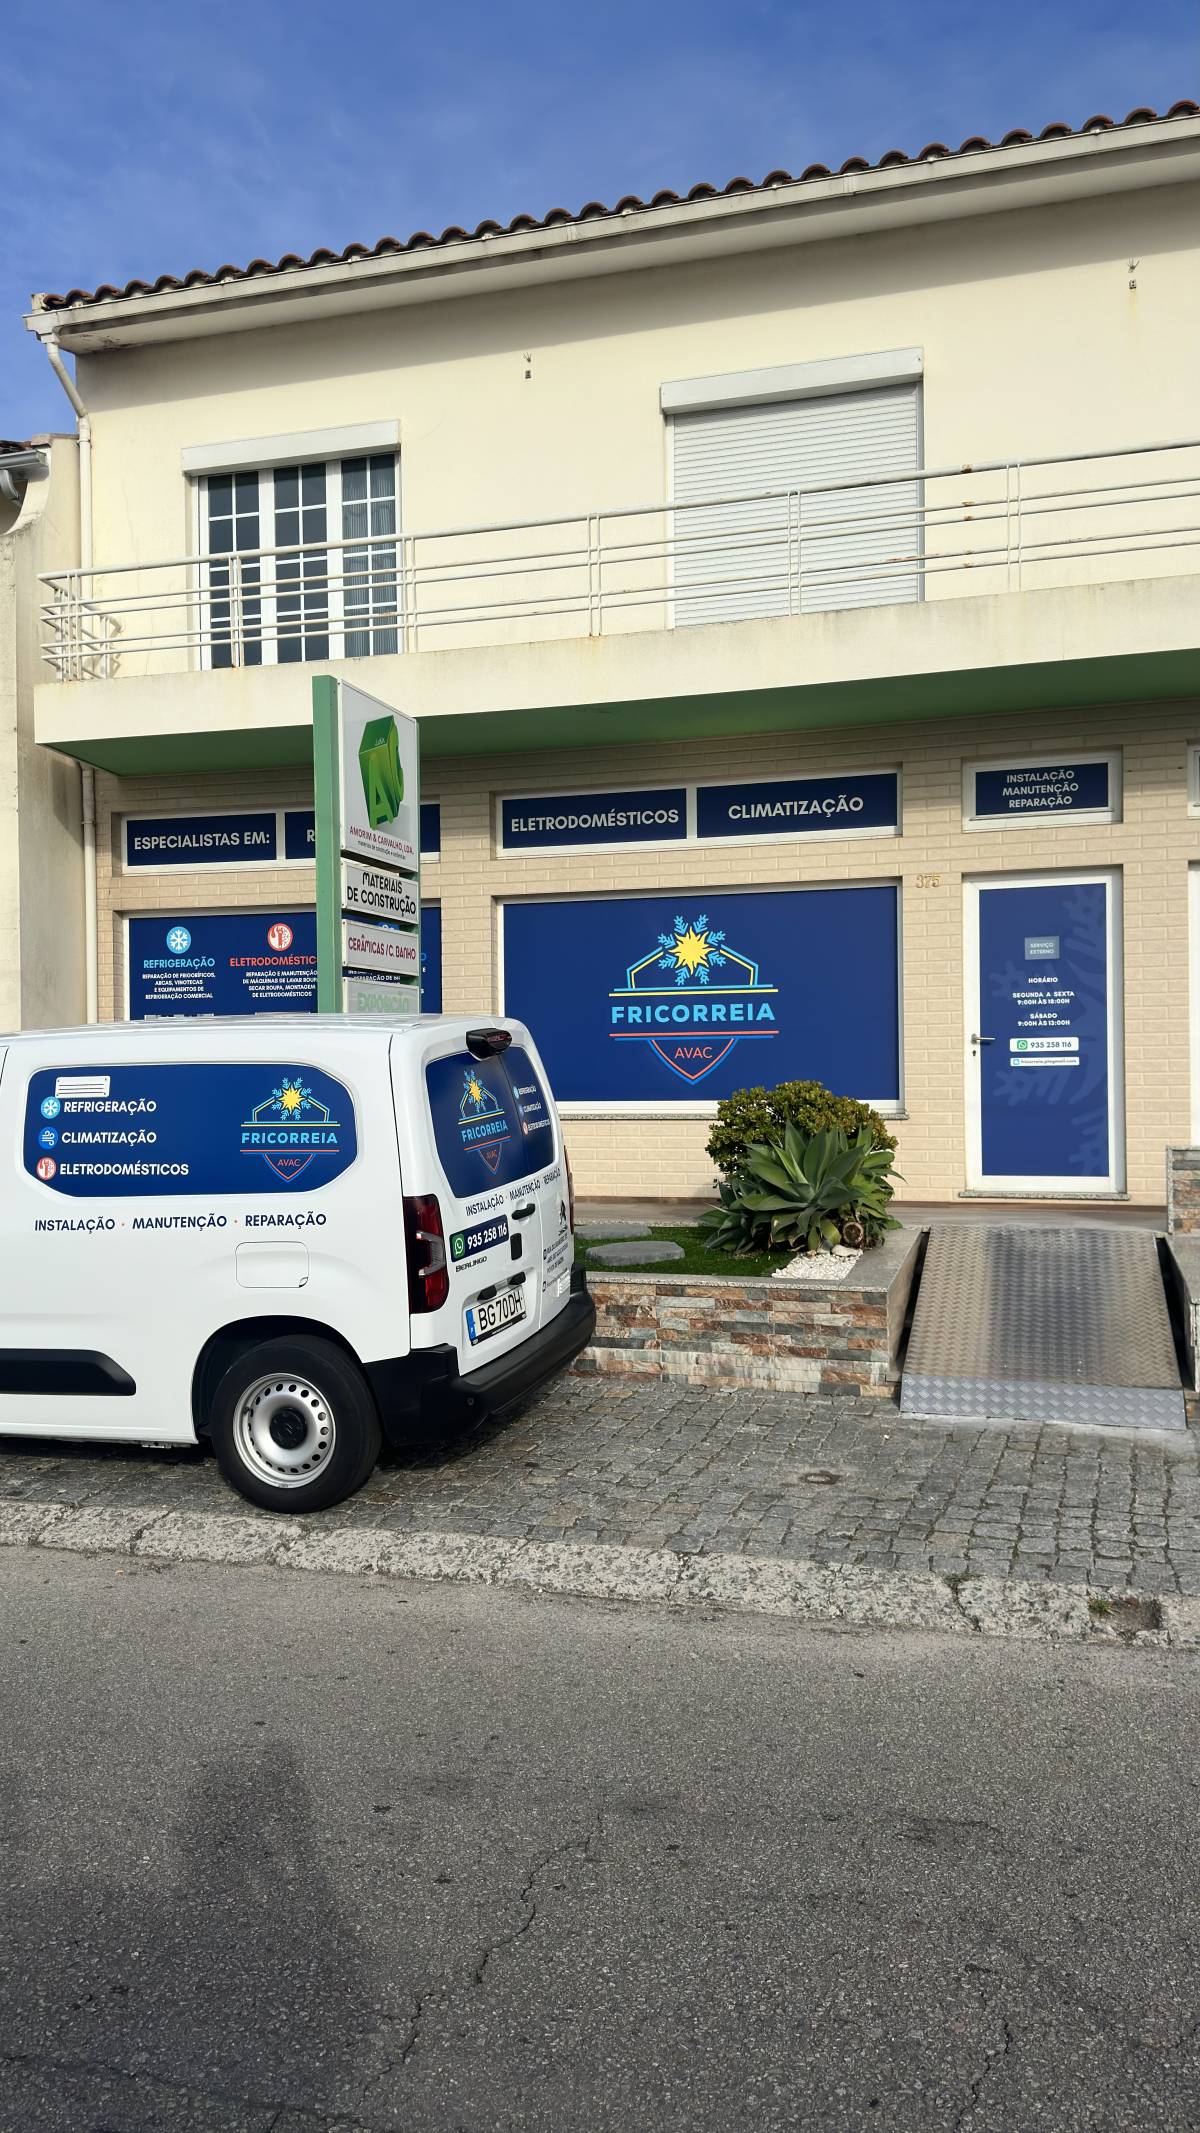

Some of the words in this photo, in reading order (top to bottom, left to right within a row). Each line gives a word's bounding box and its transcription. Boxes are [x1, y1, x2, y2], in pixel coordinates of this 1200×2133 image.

[1006, 769, 1075, 783] INSTALAÇÃO
[1002, 781, 1079, 796] MANUTENÇÃO
[728, 794, 864, 821] CLIMATIZAÇÃO
[1008, 794, 1073, 808] REPARAÇÃO
[511, 808, 679, 832] ELETRODOMÉSTICOS
[134, 832, 240, 850] ESPECIALISTAS
[243, 831, 270, 845] EM:
[349, 826, 373, 841] AMORIM
[373, 834, 377, 842] &
[363, 872, 403, 894] MATERIAIS
[915, 873, 940, 888] 375
[347, 886, 359, 902] DE
[361, 890, 417, 917] CONSTRUÇÃO
[348, 934, 385, 955] CERÂMICAS
[396, 945, 417, 960] BANHO
[143, 956, 215, 970] REFRIGERAÇÃO
[229, 954, 317, 967] ELETRODOMÉSTIC
[142, 972, 171, 980] REPARAÇÃO
[246, 970, 276, 978] REPARAÇÃO
[281, 969, 318, 977] MANUTENÇÃO
[1038, 997, 1047, 1005] ÀS
[611, 1003, 776, 1024] FRICORREIA
[674, 1046, 713, 1059] AVAC
[63, 1098, 157, 1116] REFRIGERAÇÃO
[61, 1129, 157, 1147] CLIMATIZAÇÃO
[241, 1132, 338, 1144] FRICORREIA
[461, 1120, 508, 1142] FRICORREIA
[59, 1159, 189, 1176] ELETRODOMÉSTICOS
[277, 1158, 301, 1168] AVAC
[466, 1194, 504, 1216] INSTALAÇÃO
[509, 1179, 541, 1200] MANUTENÇÃO
[34, 1216, 116, 1234] INSTALAÇÃO
[132, 1214, 228, 1232] MANUTENÇÃO
[245, 1211, 327, 1230] REPARAÇÃO
[467, 1236, 483, 1250] 935
[483, 1227, 497, 1243] 258
[498, 1222, 507, 1239] 116
[455, 1256, 488, 1273] BERLINGO
